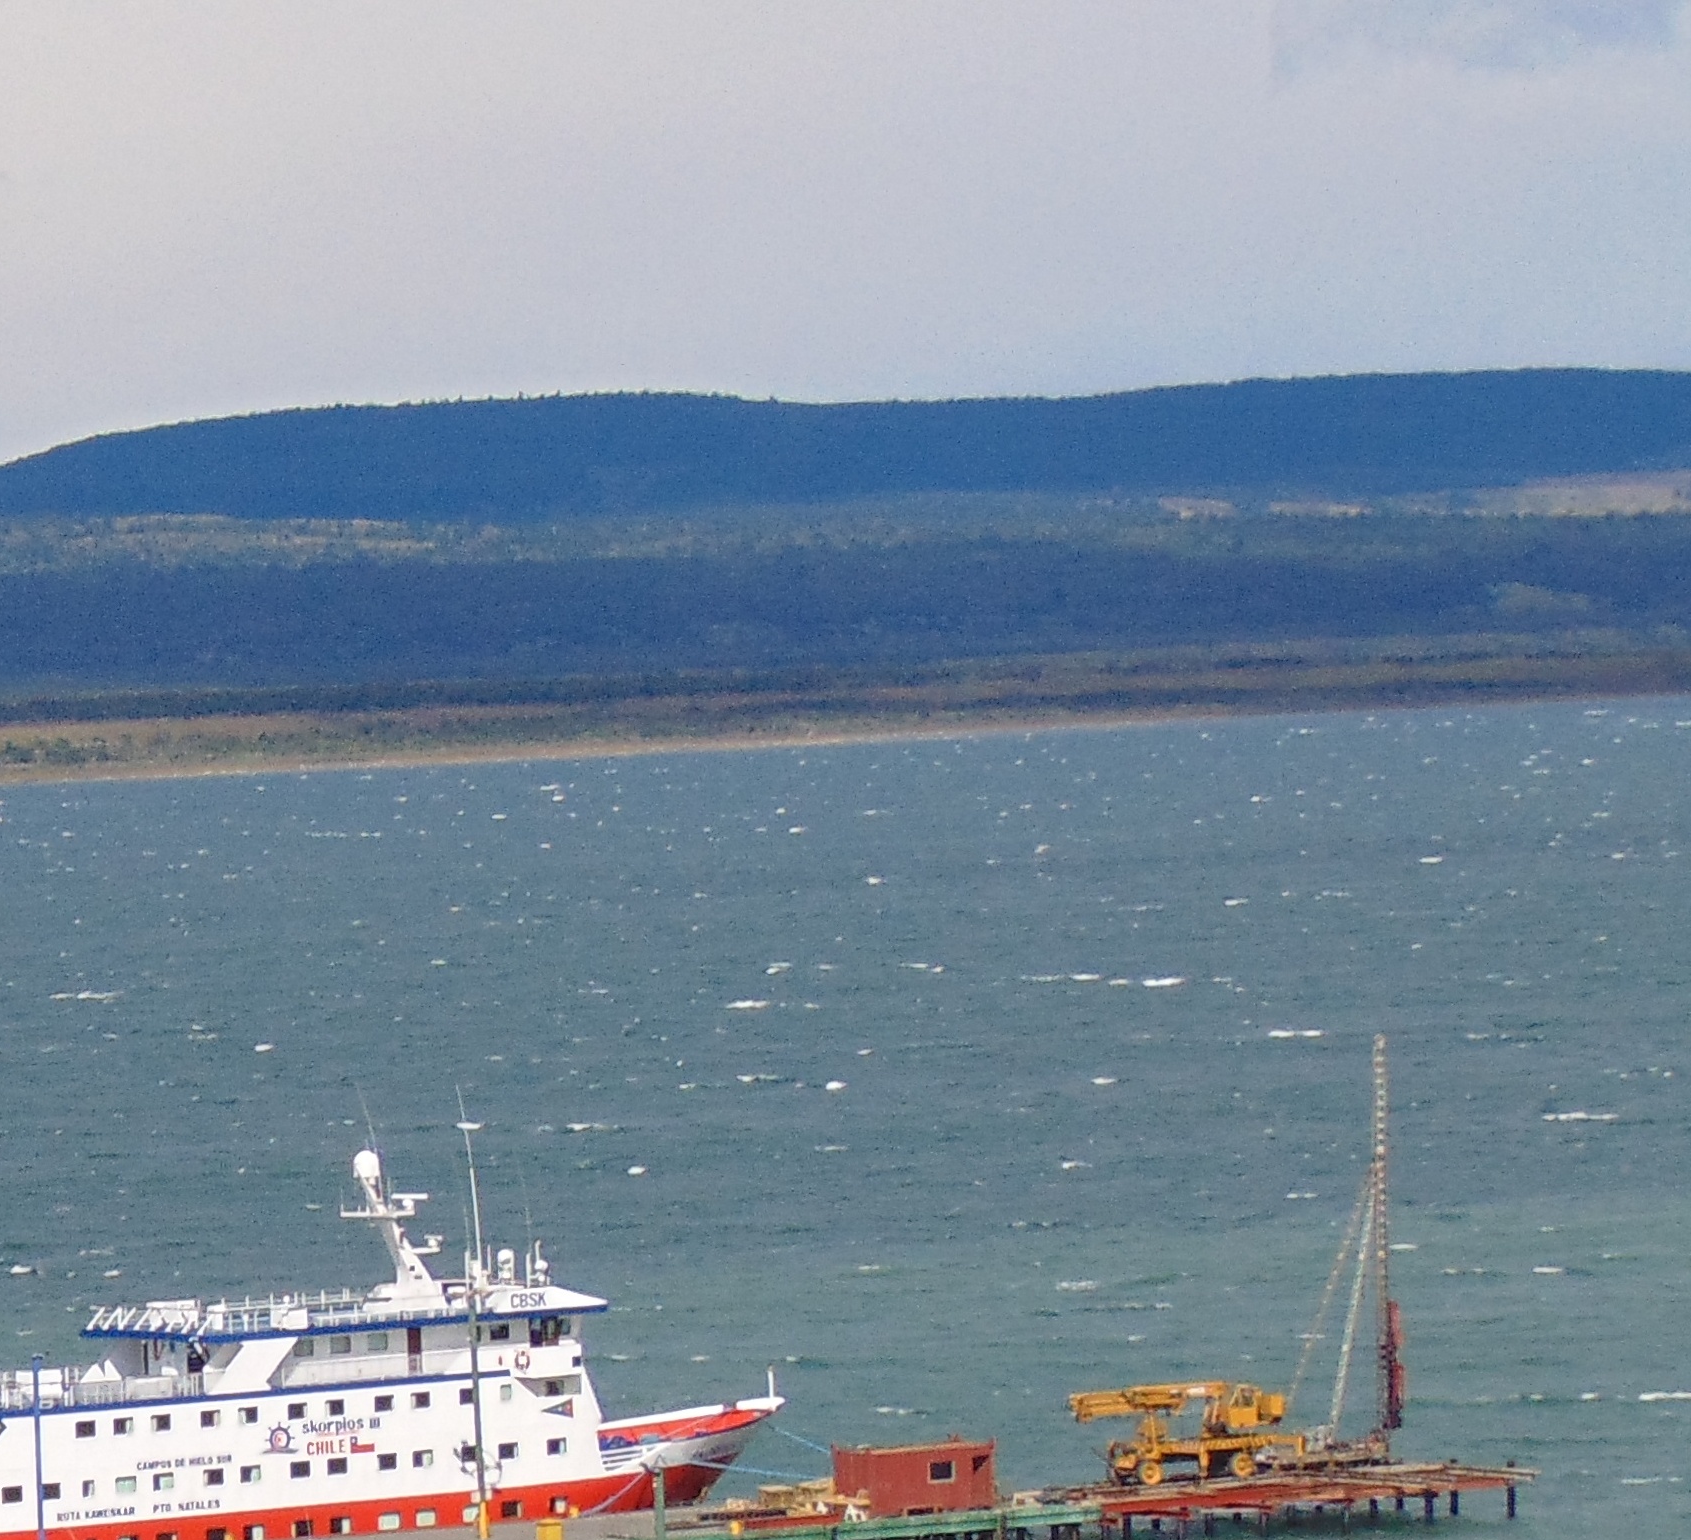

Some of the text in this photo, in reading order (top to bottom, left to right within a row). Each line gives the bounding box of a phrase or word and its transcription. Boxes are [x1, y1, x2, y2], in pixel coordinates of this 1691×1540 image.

[510, 1291, 547, 1308] CBSK
[306, 1439, 346, 1456] CHILE
[174, 1458, 186, 1468] DE
[178, 1500, 220, 1512] NATALES
